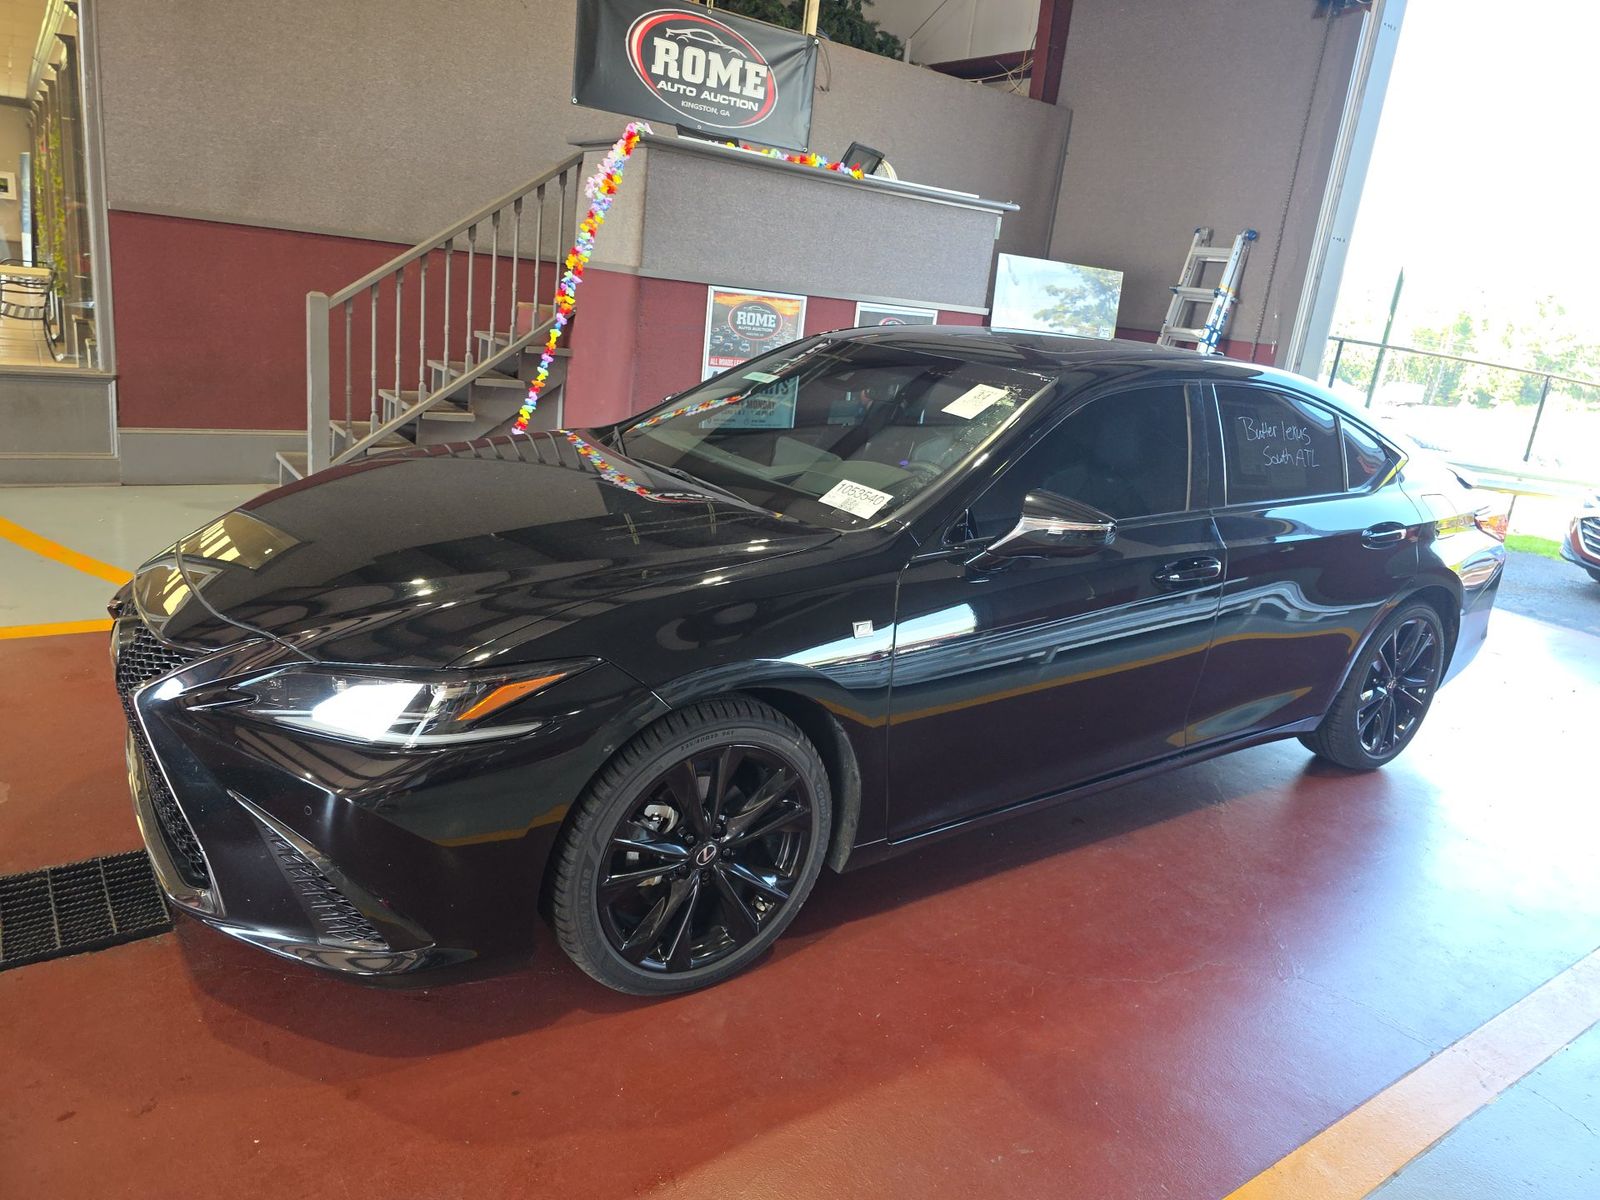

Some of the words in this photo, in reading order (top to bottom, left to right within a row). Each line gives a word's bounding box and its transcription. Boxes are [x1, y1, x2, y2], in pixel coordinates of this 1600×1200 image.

[651, 37, 768, 99] ROME
[657, 80, 697, 97] AUTO
[701, 91, 759, 111] AUCTION
[681, 100, 719, 115] KINGSTON,
[720, 109, 730, 117] GA
[736, 311, 777, 328] ROME
[1238, 416, 1277, 441] Butter
[1263, 445, 1294, 467] South
[1295, 449, 1320, 468] ATL
[837, 482, 885, 506] 1053540
